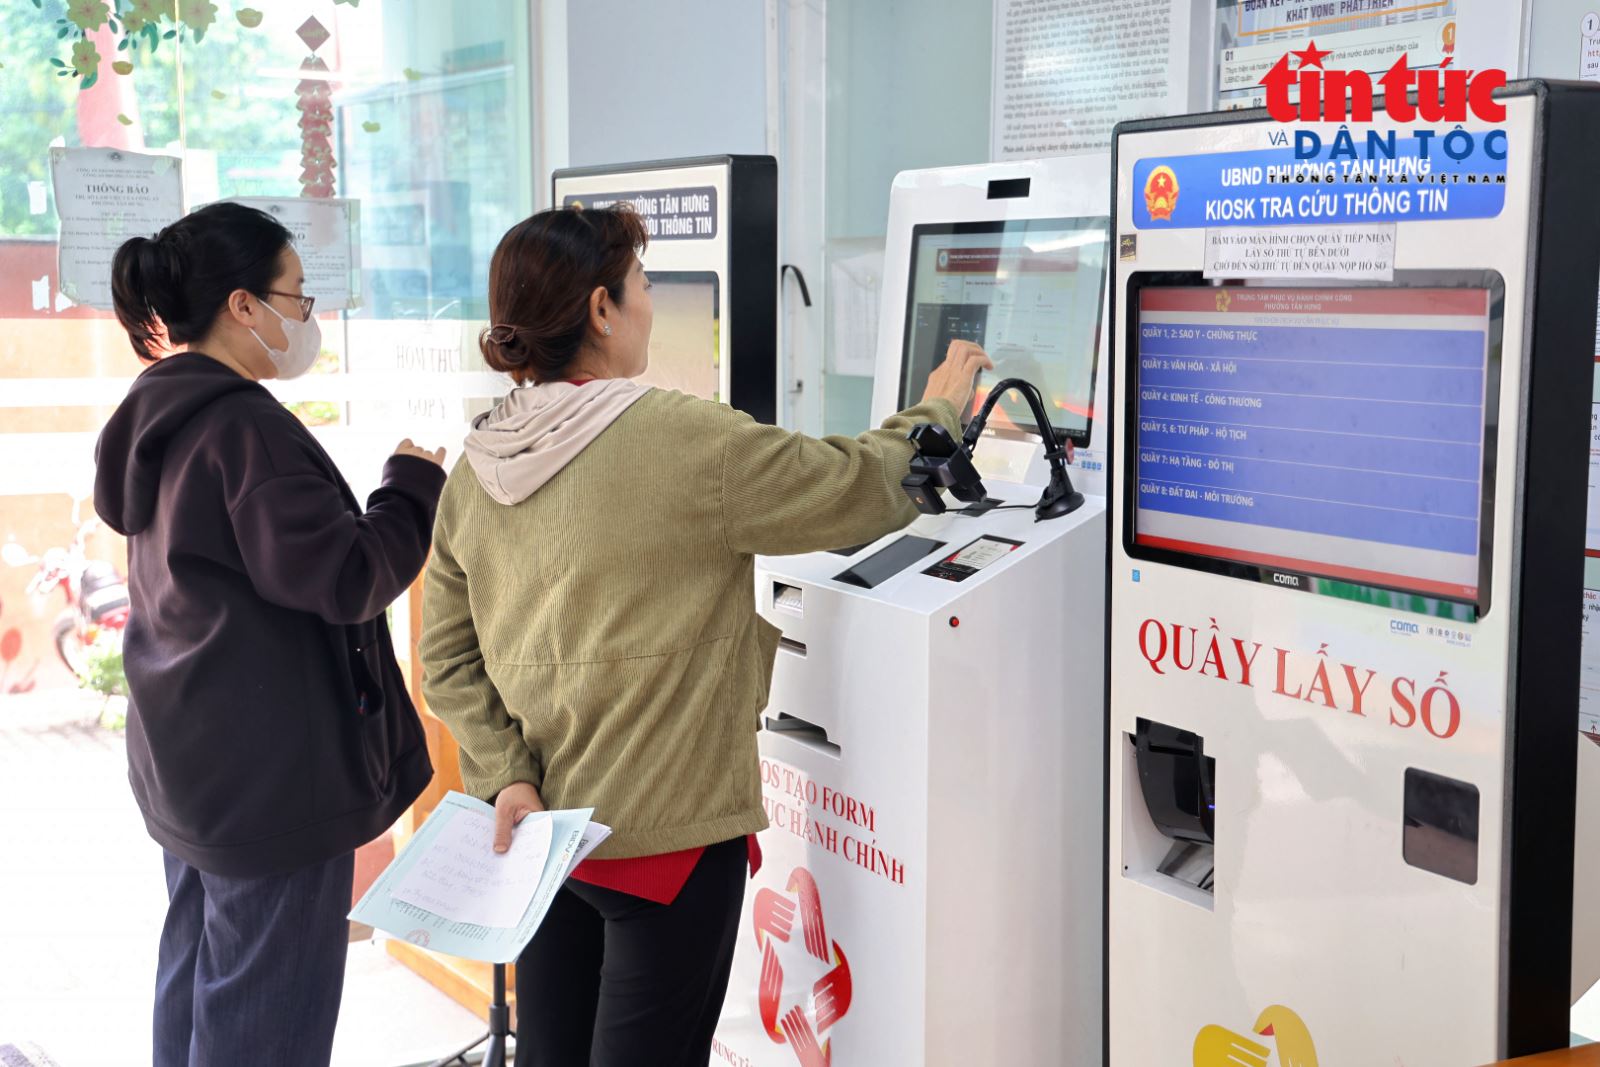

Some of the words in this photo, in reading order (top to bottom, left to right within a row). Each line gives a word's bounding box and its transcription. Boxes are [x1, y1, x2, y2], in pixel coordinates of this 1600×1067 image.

[1225, 51, 1234, 61] 01
[1221, 166, 1262, 187] UBND
[1266, 159, 1337, 185] PHƯỜNG
[1379, 155, 1431, 178] HƯNG
[87, 182, 124, 193] THÔNG
[127, 183, 149, 194] BÁO
[659, 194, 679, 214] TÂN
[681, 194, 710, 213] HƯNG
[1205, 198, 1256, 221] KIOSK
[1260, 196, 1294, 219] TRA
[1298, 189, 1338, 217] CỨU
[1344, 186, 1411, 215] THÔNG
[1417, 188, 1449, 213] TIN
[660, 216, 693, 235] THÔNG
[695, 216, 713, 234] TIN
[1269, 233, 1289, 245] HÌNH
[1290, 234, 1315, 245] CHỌN
[1142, 327, 1162, 338] QUẦY
[1179, 330, 1194, 339] SAO
[1206, 327, 1234, 340] CHỨNG
[1235, 331, 1258, 343] THỰC
[1142, 358, 1161, 369] QUẦY
[1170, 360, 1186, 370] VĂN
[1188, 360, 1204, 372] HÓA
[1210, 362, 1221, 373] XÃ
[1223, 361, 1237, 374] HỘI
[1141, 389, 1161, 401] QUẦY
[1170, 392, 1189, 403] KINH
[1189, 391, 1200, 404] TẾ
[1205, 393, 1227, 405] CÔNG
[1229, 396, 1262, 408] THƯƠNG
[1141, 420, 1161, 433] QUẦY
[1178, 425, 1188, 435] TƯ
[1189, 424, 1209, 437] PHÁP
[1216, 426, 1227, 440] HỘ
[1229, 429, 1247, 441] TỊCH
[1141, 452, 1160, 464] QUẦY
[1169, 456, 1180, 468] HẠ
[1181, 455, 1202, 468] TẦNG
[1221, 461, 1235, 474] THỊ
[1140, 482, 1160, 494] QUẦY
[1169, 486, 1185, 498] ĐẤT
[1185, 489, 1198, 500] ĐAI
[1204, 490, 1220, 503] MÔI
[1221, 493, 1254, 507] TRƯỜNG
[1138, 617, 1263, 689] QUẦY
[1272, 642, 1377, 718] LẤY
[1389, 671, 1461, 740] SỐ
[760, 759, 780, 789] OS
[783, 768, 818, 806] TẠO
[822, 786, 876, 833] FORM
[790, 808, 838, 855] HÀNH
[843, 835, 905, 885] CHÍNH
[712, 1037, 737, 1067] RUNG
